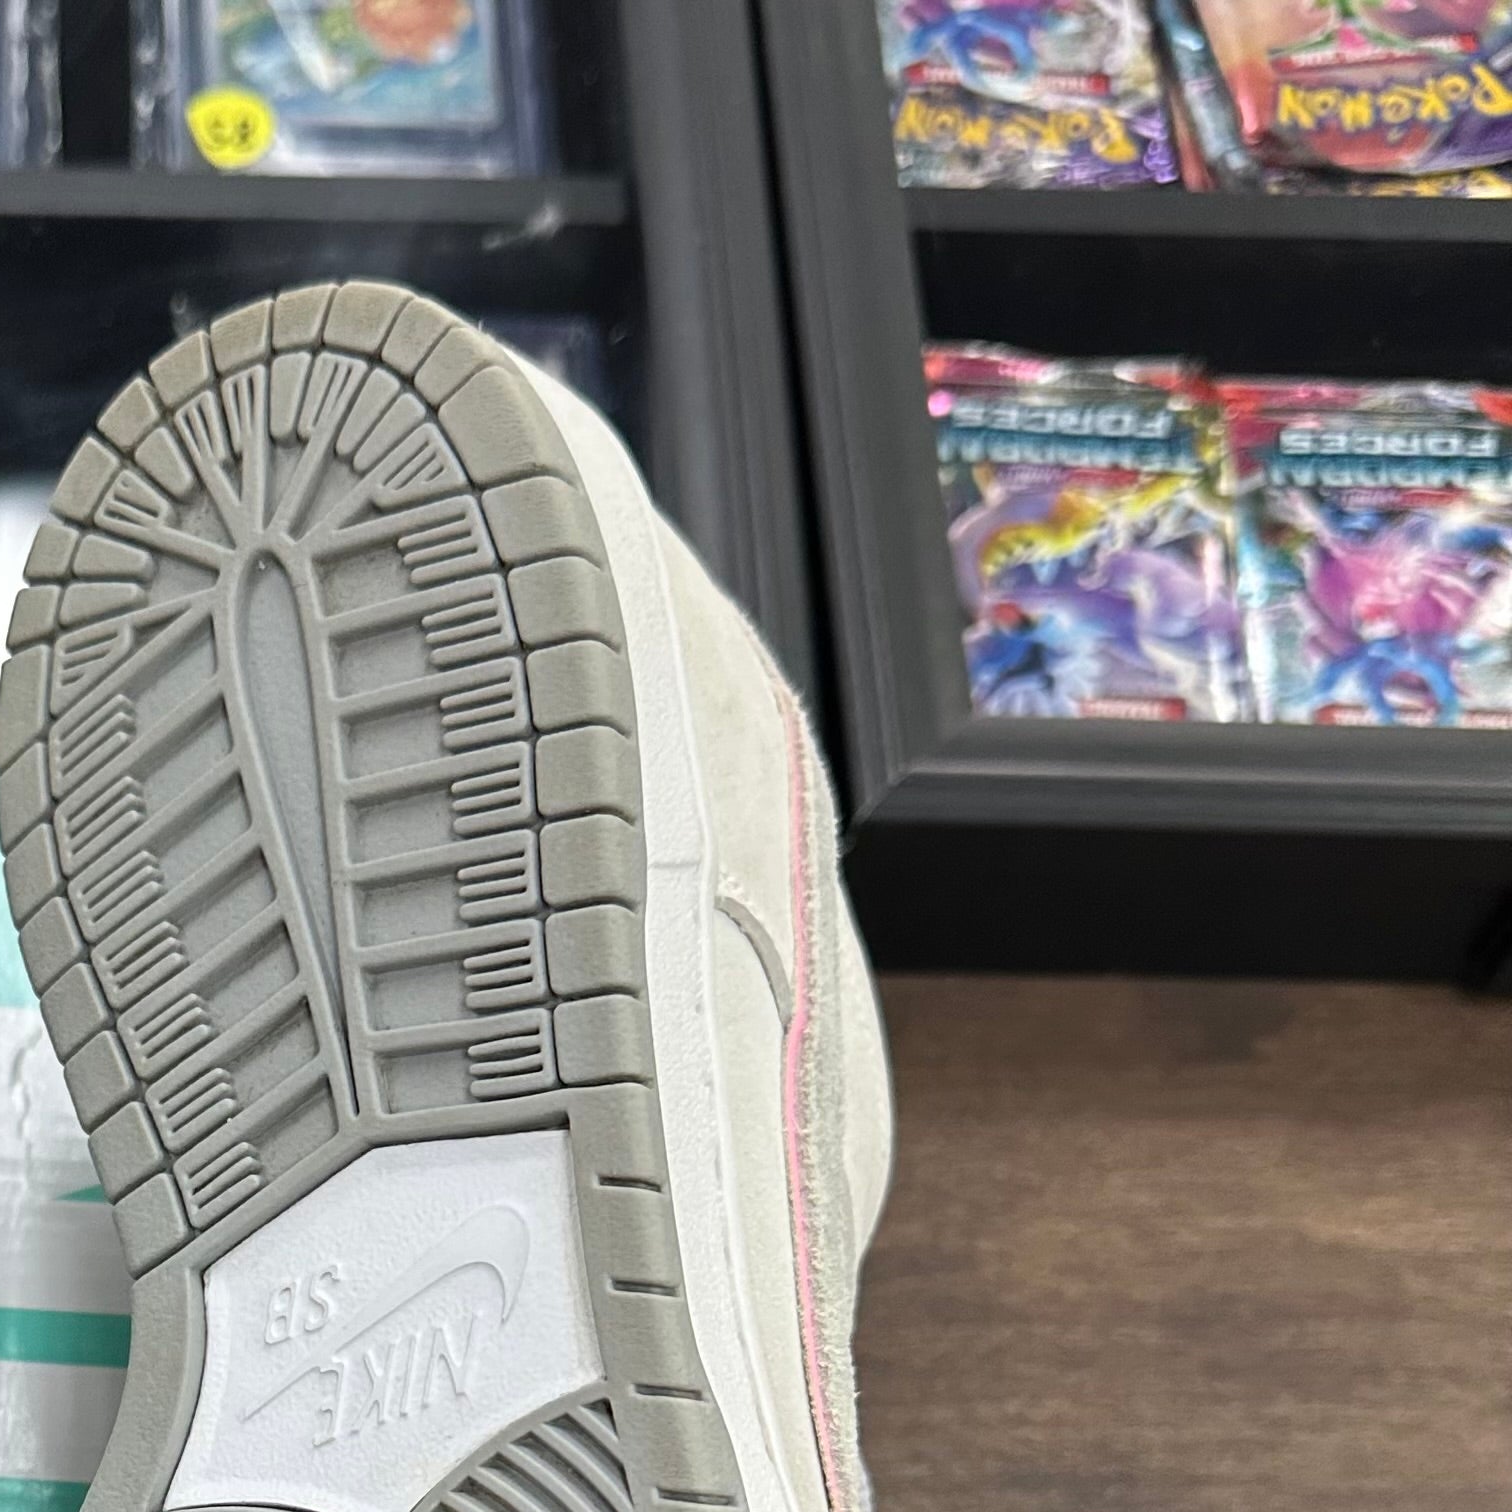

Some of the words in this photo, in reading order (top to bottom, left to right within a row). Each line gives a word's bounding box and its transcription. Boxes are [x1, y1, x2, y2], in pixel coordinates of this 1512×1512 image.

[950, 402, 1176, 441] FORCES
[1279, 429, 1499, 457] FORCES
[264, 1264, 341, 1345] SB
[312, 1310, 484, 1448] NIKE
